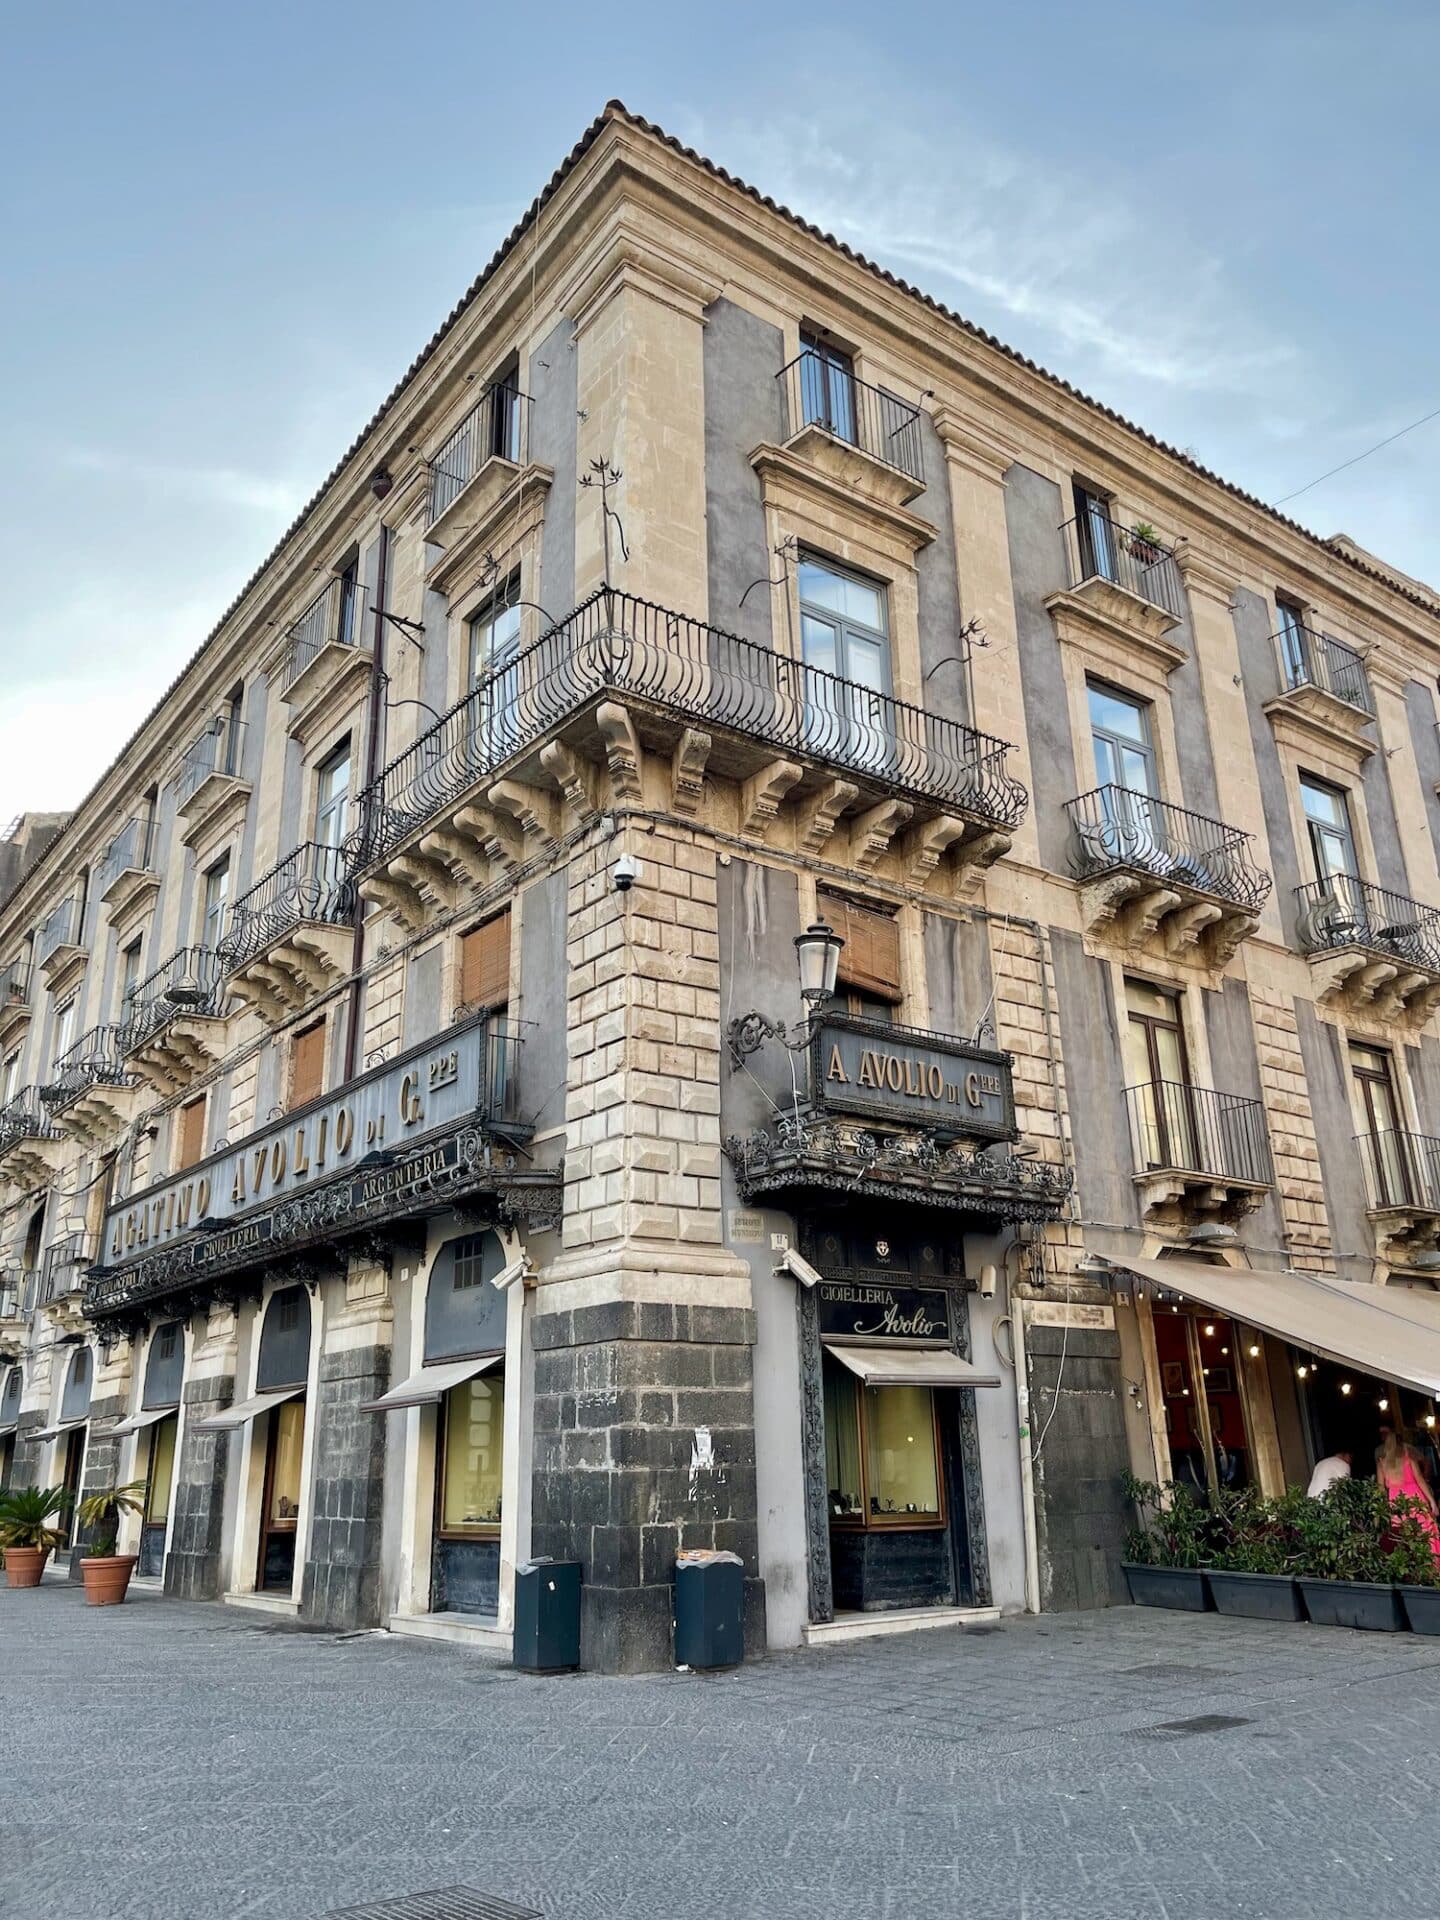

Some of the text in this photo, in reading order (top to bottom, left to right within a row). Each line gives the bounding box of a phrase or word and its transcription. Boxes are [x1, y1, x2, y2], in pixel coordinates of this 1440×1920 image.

[826, 1044, 850, 1083] A.
[856, 1049, 944, 1101] AVOLIO
[946, 1083, 960, 1106] DI
[112, 1176, 211, 1255] AGATINO
[231, 1106, 353, 1203] AVOLIO
[366, 1114, 385, 1144] DI
[362, 1149, 446, 1201] ARGENTERIA
[203, 1224, 260, 1259] GIOIELLERIA
[820, 1285, 895, 1305] GIOIELLERIA
[853, 1303, 947, 1336] Avolio
